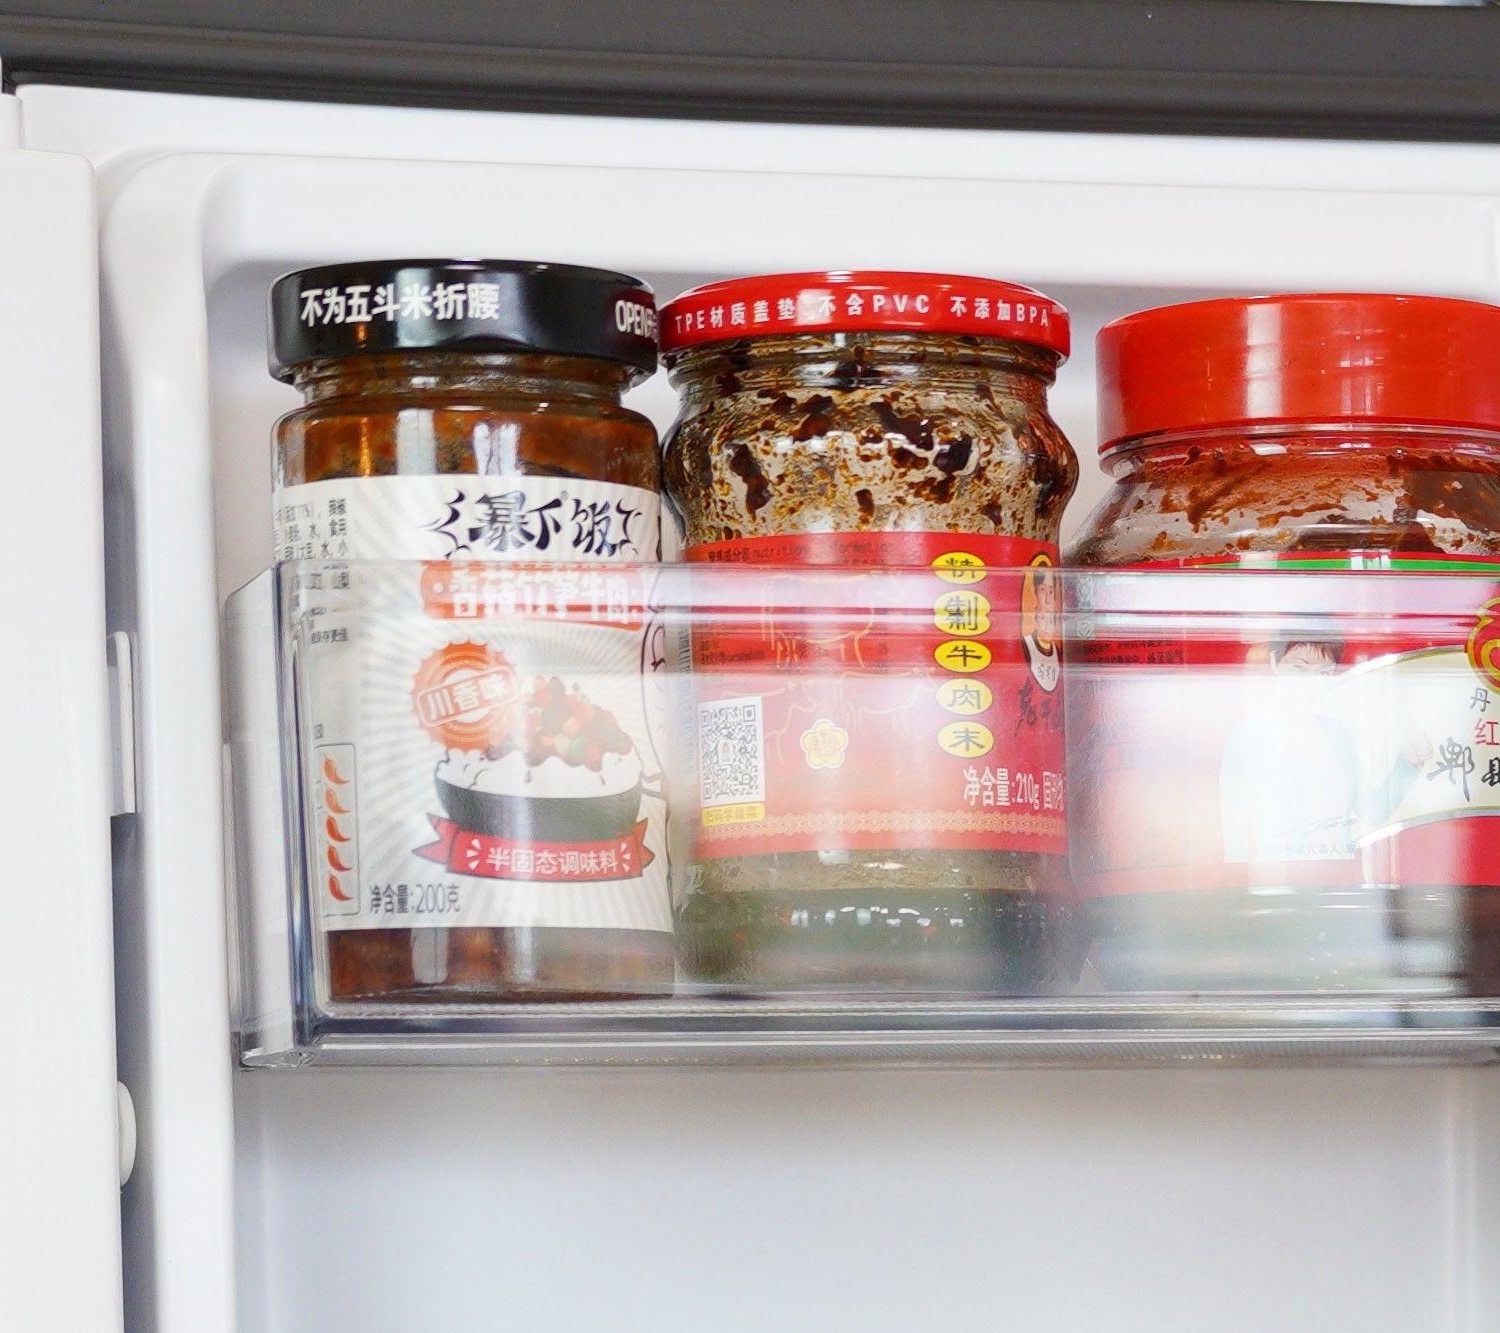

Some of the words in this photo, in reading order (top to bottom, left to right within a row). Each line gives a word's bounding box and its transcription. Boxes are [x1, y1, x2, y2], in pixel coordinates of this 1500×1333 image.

[301, 282, 500, 327] 不为五斗米折腰
[675, 298, 796, 334] TPE材质盖垫
[818, 294, 930, 316] 不含PVC
[952, 297, 1050, 327] 不添加BPA
[470, 489, 615, 556] 暴下饭
[426, 674, 510, 719] 川香味
[487, 847, 619, 875] 半固态调味料
[370, 883, 461, 914] 净含量:200克
